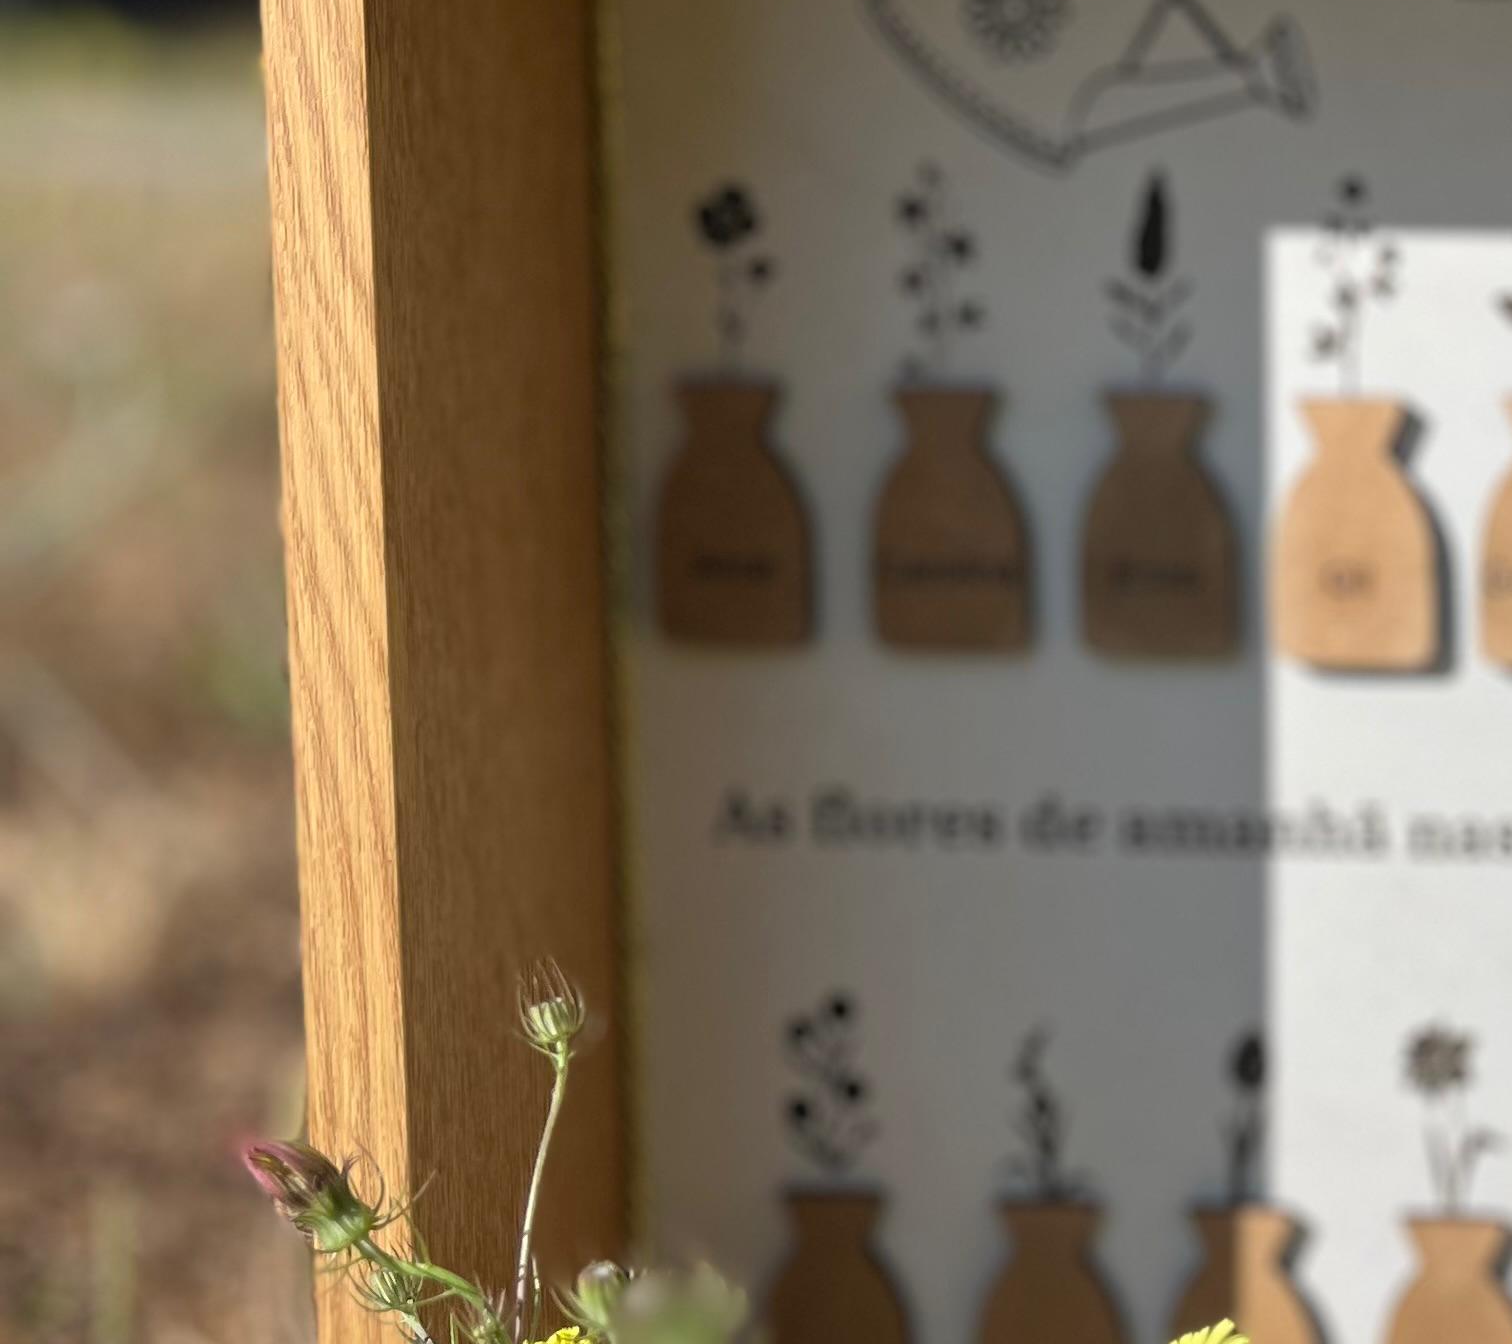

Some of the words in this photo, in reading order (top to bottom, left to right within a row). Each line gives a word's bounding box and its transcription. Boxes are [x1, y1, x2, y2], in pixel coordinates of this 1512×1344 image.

[714, 788, 795, 852] As
[812, 784, 1002, 852] flores
[1020, 794, 1102, 854] de
